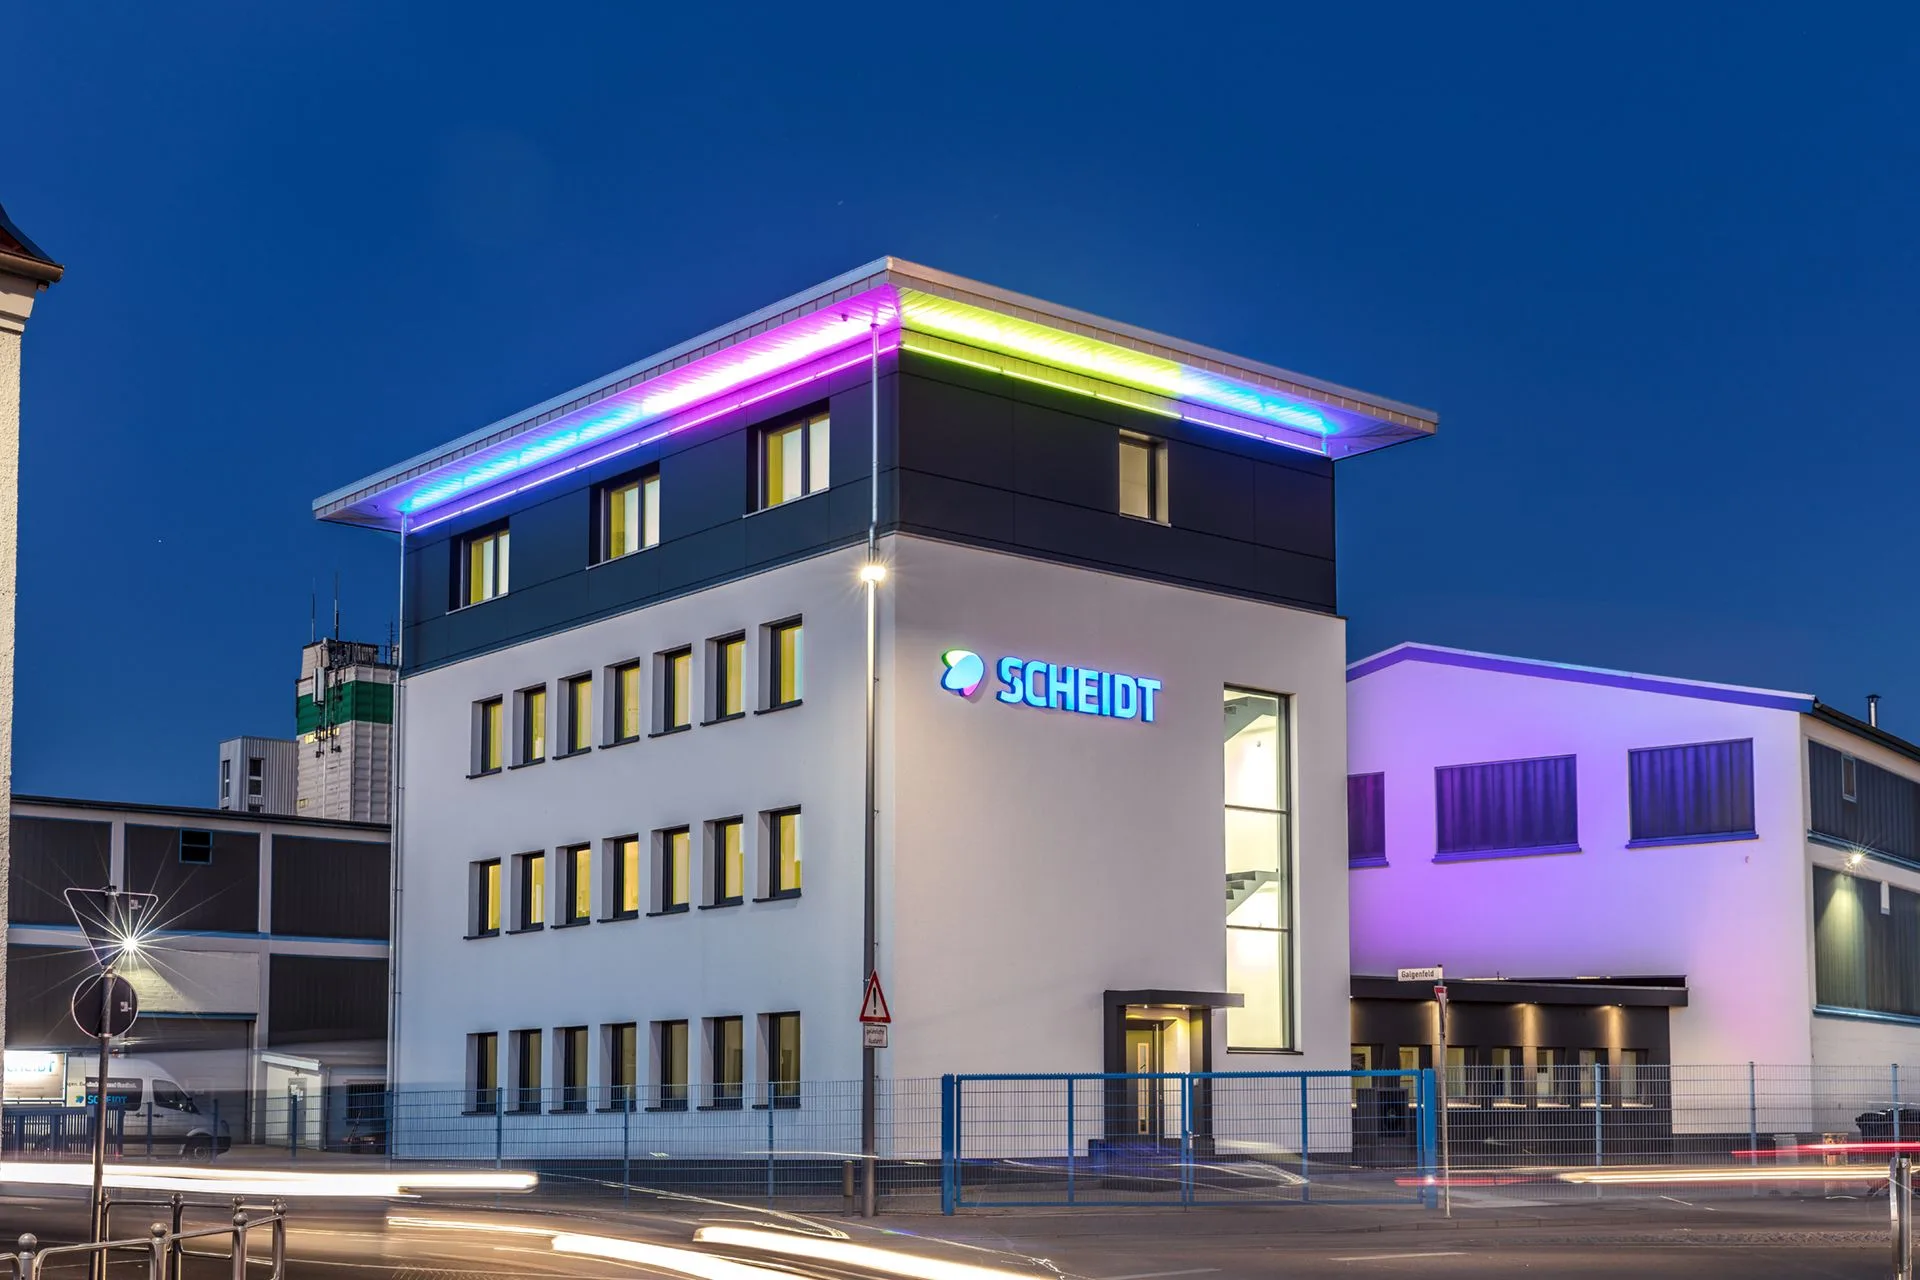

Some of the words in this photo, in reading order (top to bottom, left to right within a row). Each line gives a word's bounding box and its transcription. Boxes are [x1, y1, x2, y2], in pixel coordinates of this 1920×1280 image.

[997, 655, 1161, 722] SCHEIDT
[1401, 970, 1435, 979] Galgenfeld
[87, 1094, 127, 1105] SCEIDT
